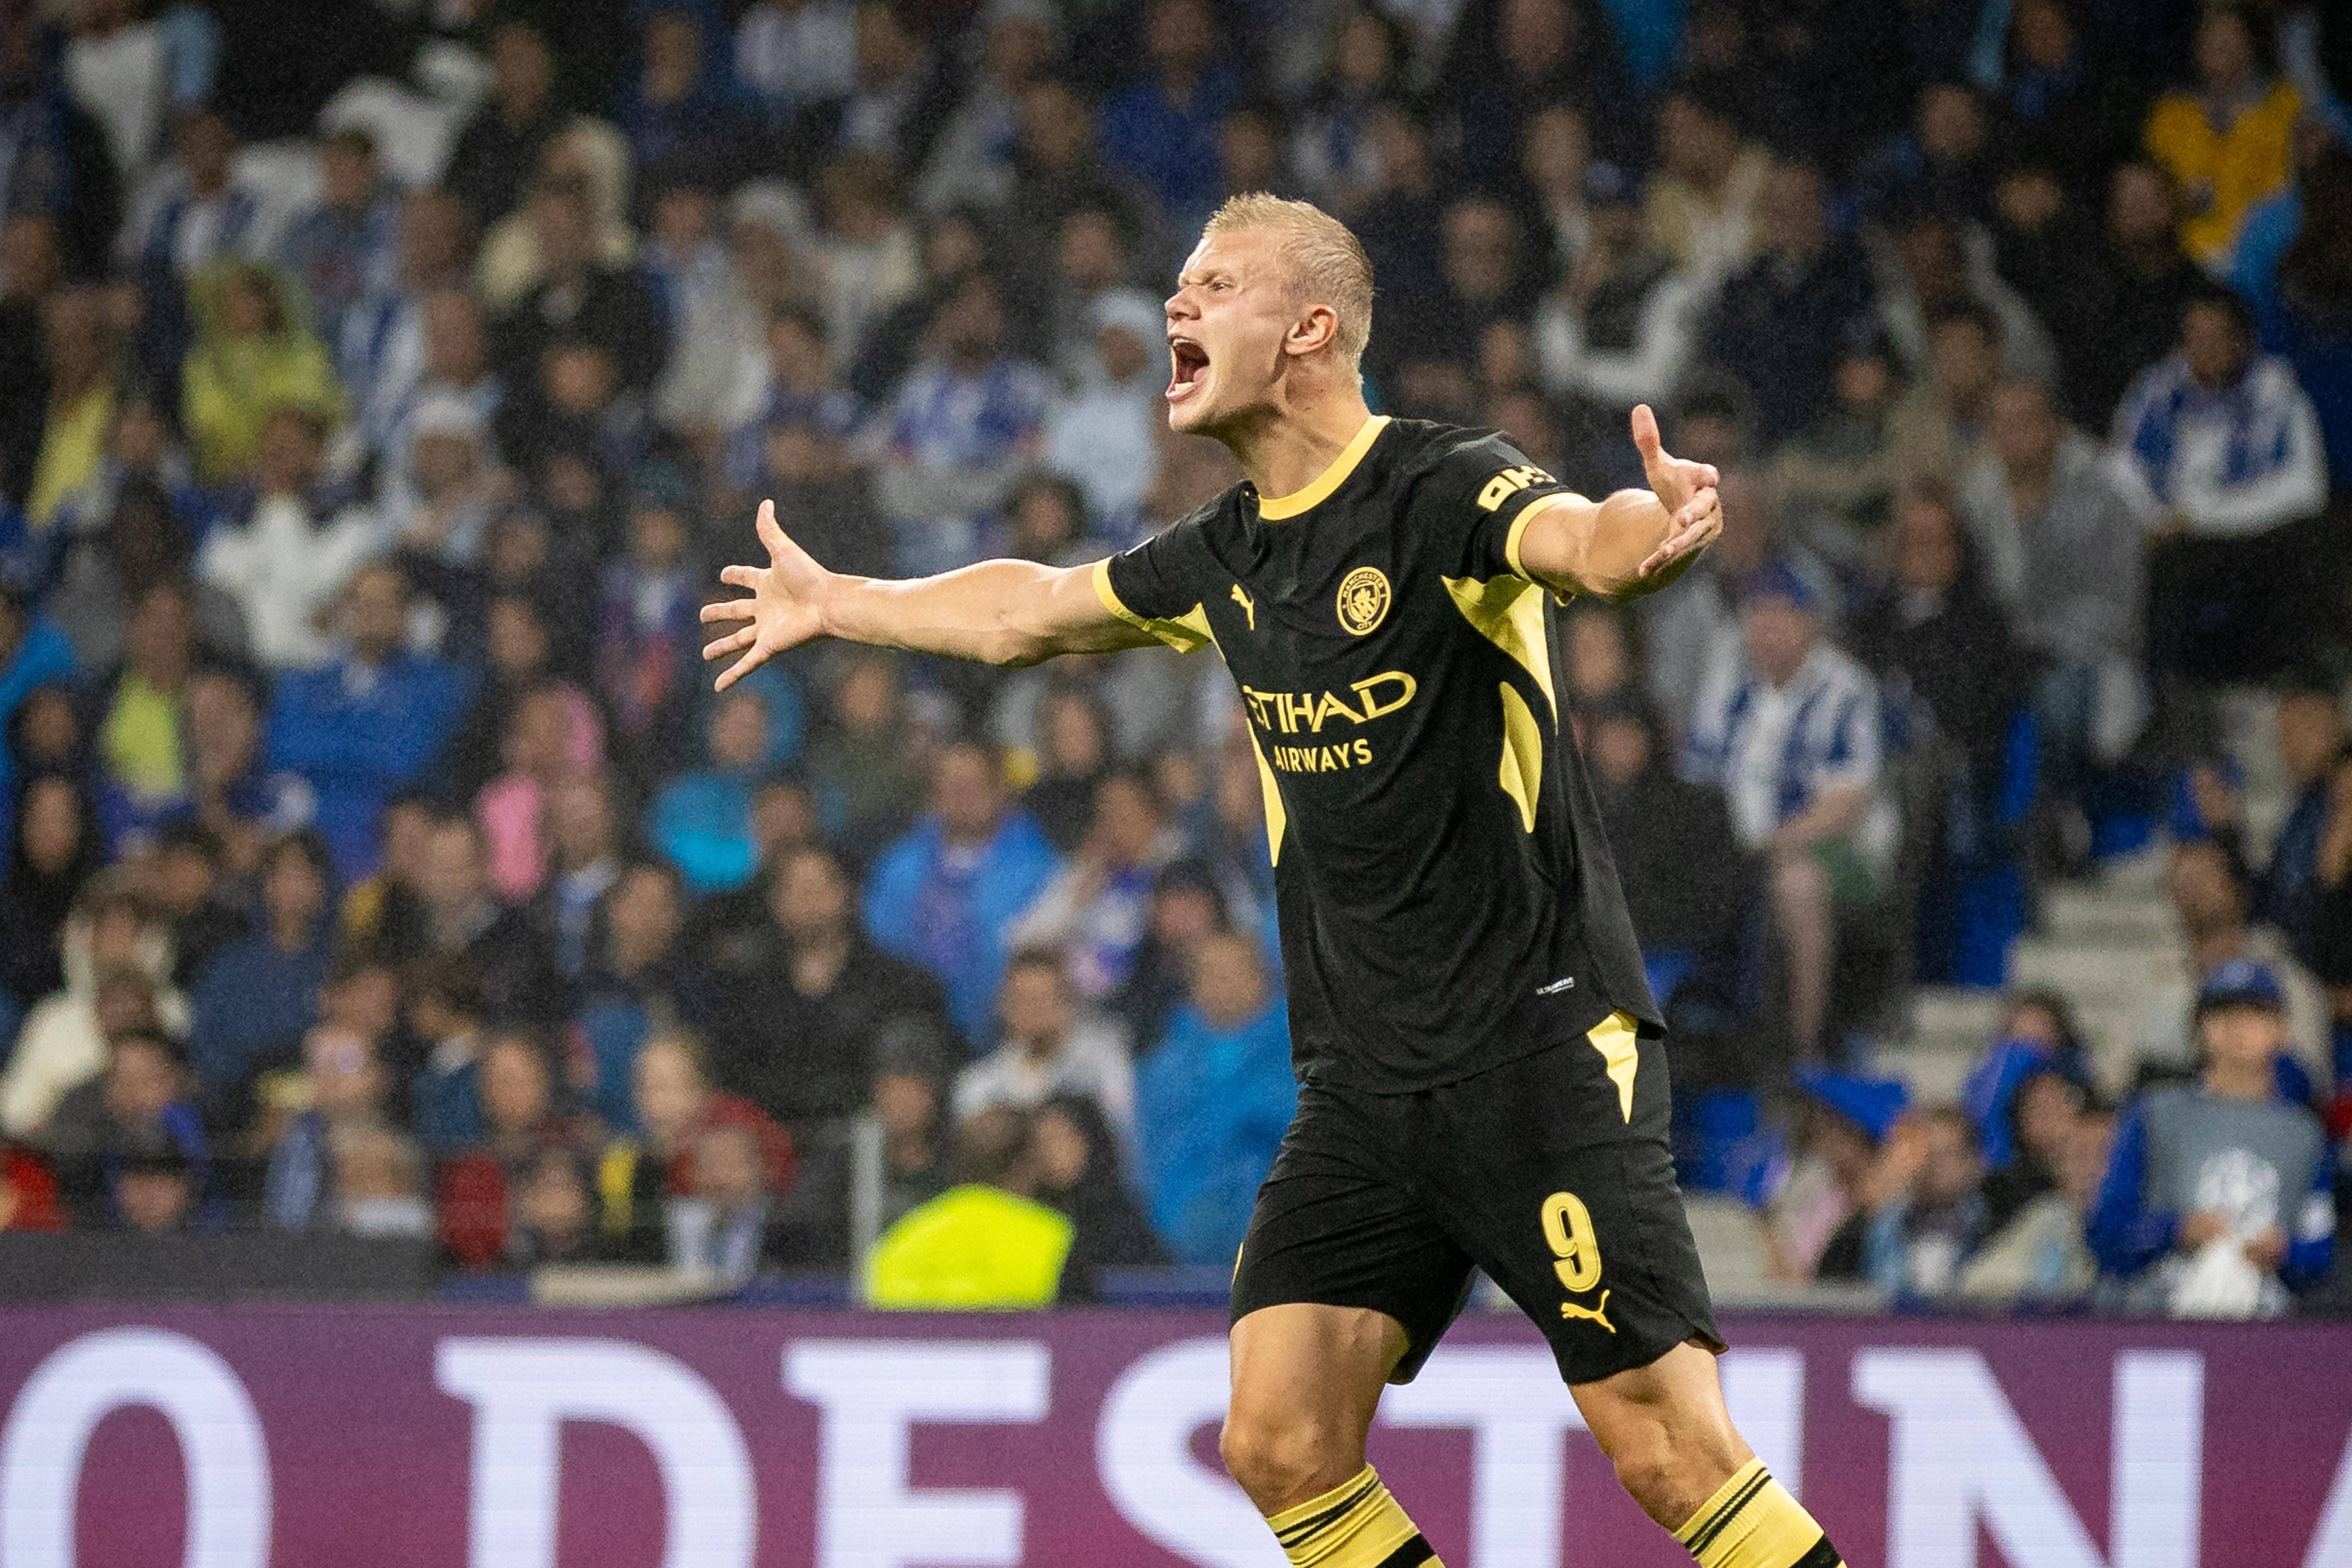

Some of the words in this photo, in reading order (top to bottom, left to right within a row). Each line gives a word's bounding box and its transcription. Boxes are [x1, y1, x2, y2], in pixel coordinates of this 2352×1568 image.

[1342, 572, 1384, 598] MANCHESTER
[1357, 621, 1373, 630] CITY
[1274, 739, 1372, 772] AIRWAYS
[1541, 1192, 1601, 1292] 9
[434, 1334, 2352, 1568] DETN
